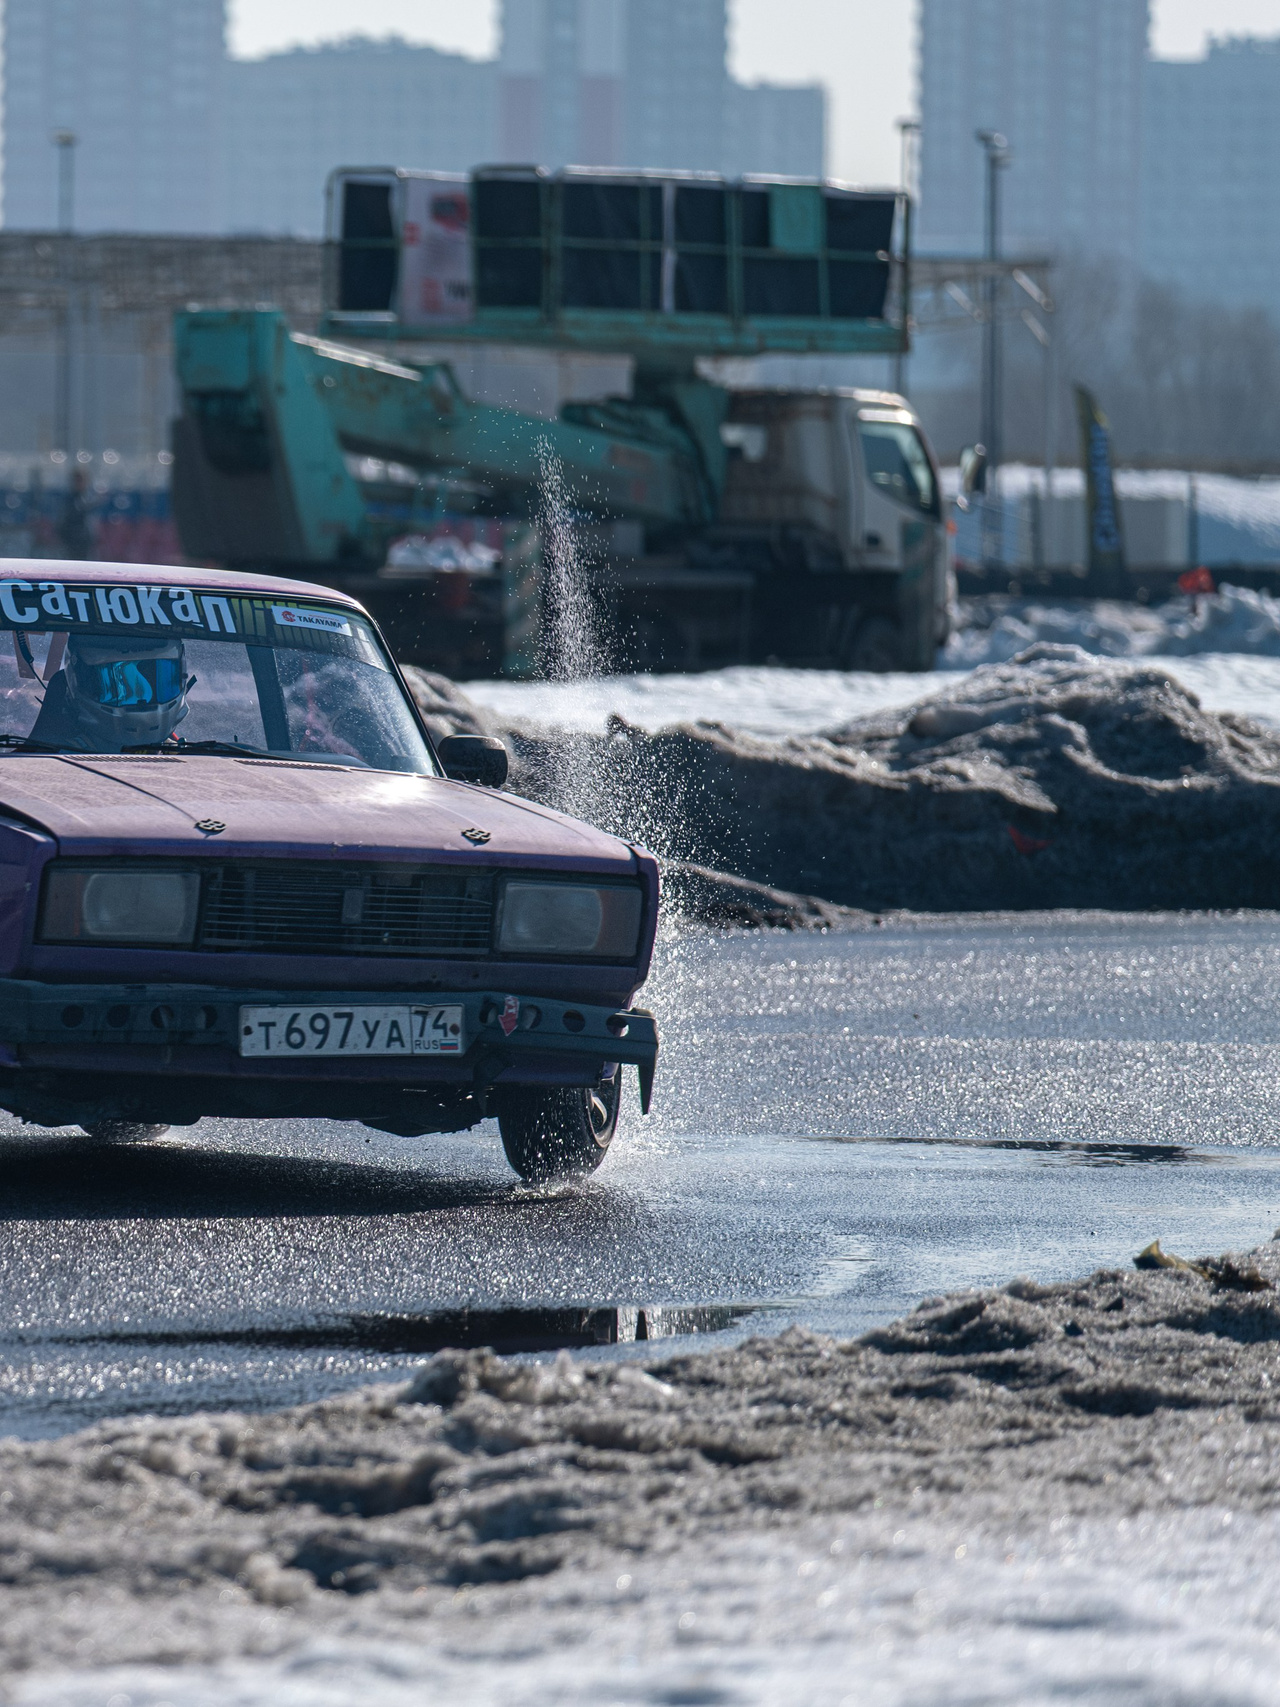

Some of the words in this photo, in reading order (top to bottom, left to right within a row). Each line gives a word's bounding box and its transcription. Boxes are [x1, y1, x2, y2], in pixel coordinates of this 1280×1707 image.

[297, 615, 343, 629] TAKAYAMA
[414, 1010, 448, 1038] 74
[415, 1039, 439, 1050] RUS
